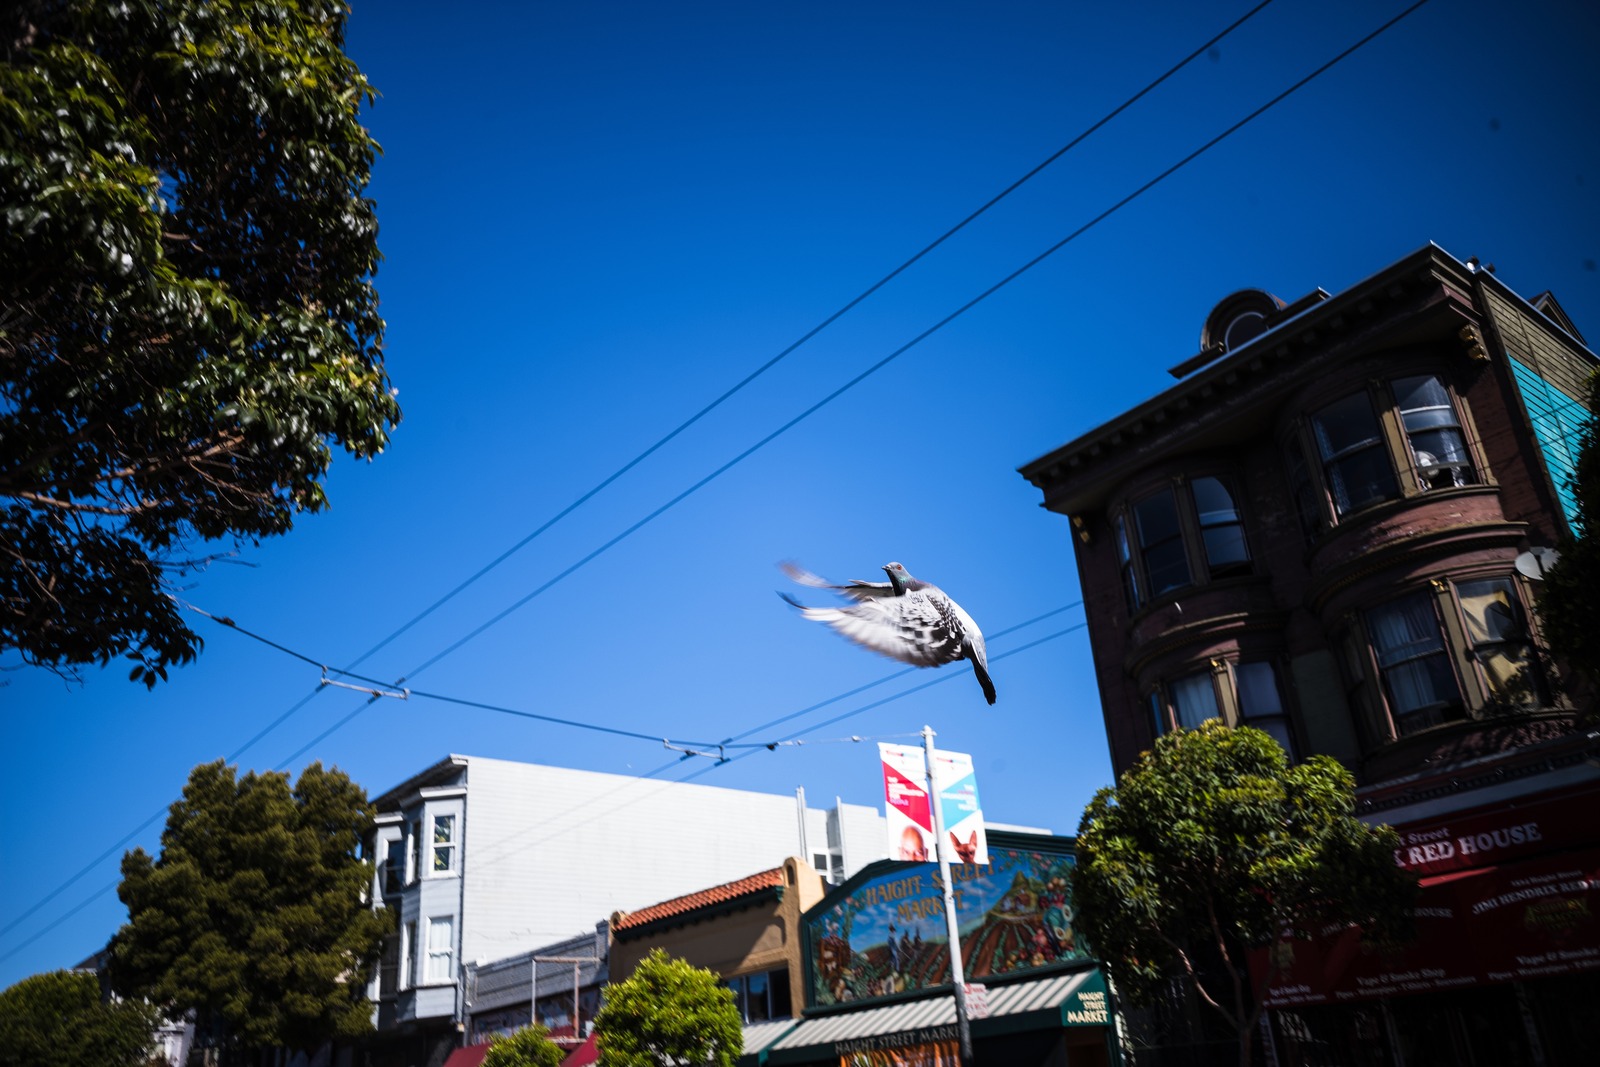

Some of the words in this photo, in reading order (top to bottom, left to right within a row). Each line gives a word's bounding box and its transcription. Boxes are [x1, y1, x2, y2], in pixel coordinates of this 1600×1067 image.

[1407, 827, 1450, 844] Street
[1407, 840, 1456, 865] RED
[1457, 822, 1543, 855] HOUSE
[866, 875, 922, 907] HAIGHT
[931, 856, 996, 889] SREET
[897, 889, 964, 923] MARKT
[1471, 897, 1498, 915] JIMI
[1498, 883, 1559, 904] HENDRIX
[1077, 991, 1105, 1001] HAIGHT
[1082, 1000, 1106, 1010] STREET
[1067, 1010, 1108, 1023] MARKET
[834, 1037, 876, 1055] HAIGHT
[878, 1031, 916, 1050] STREET
